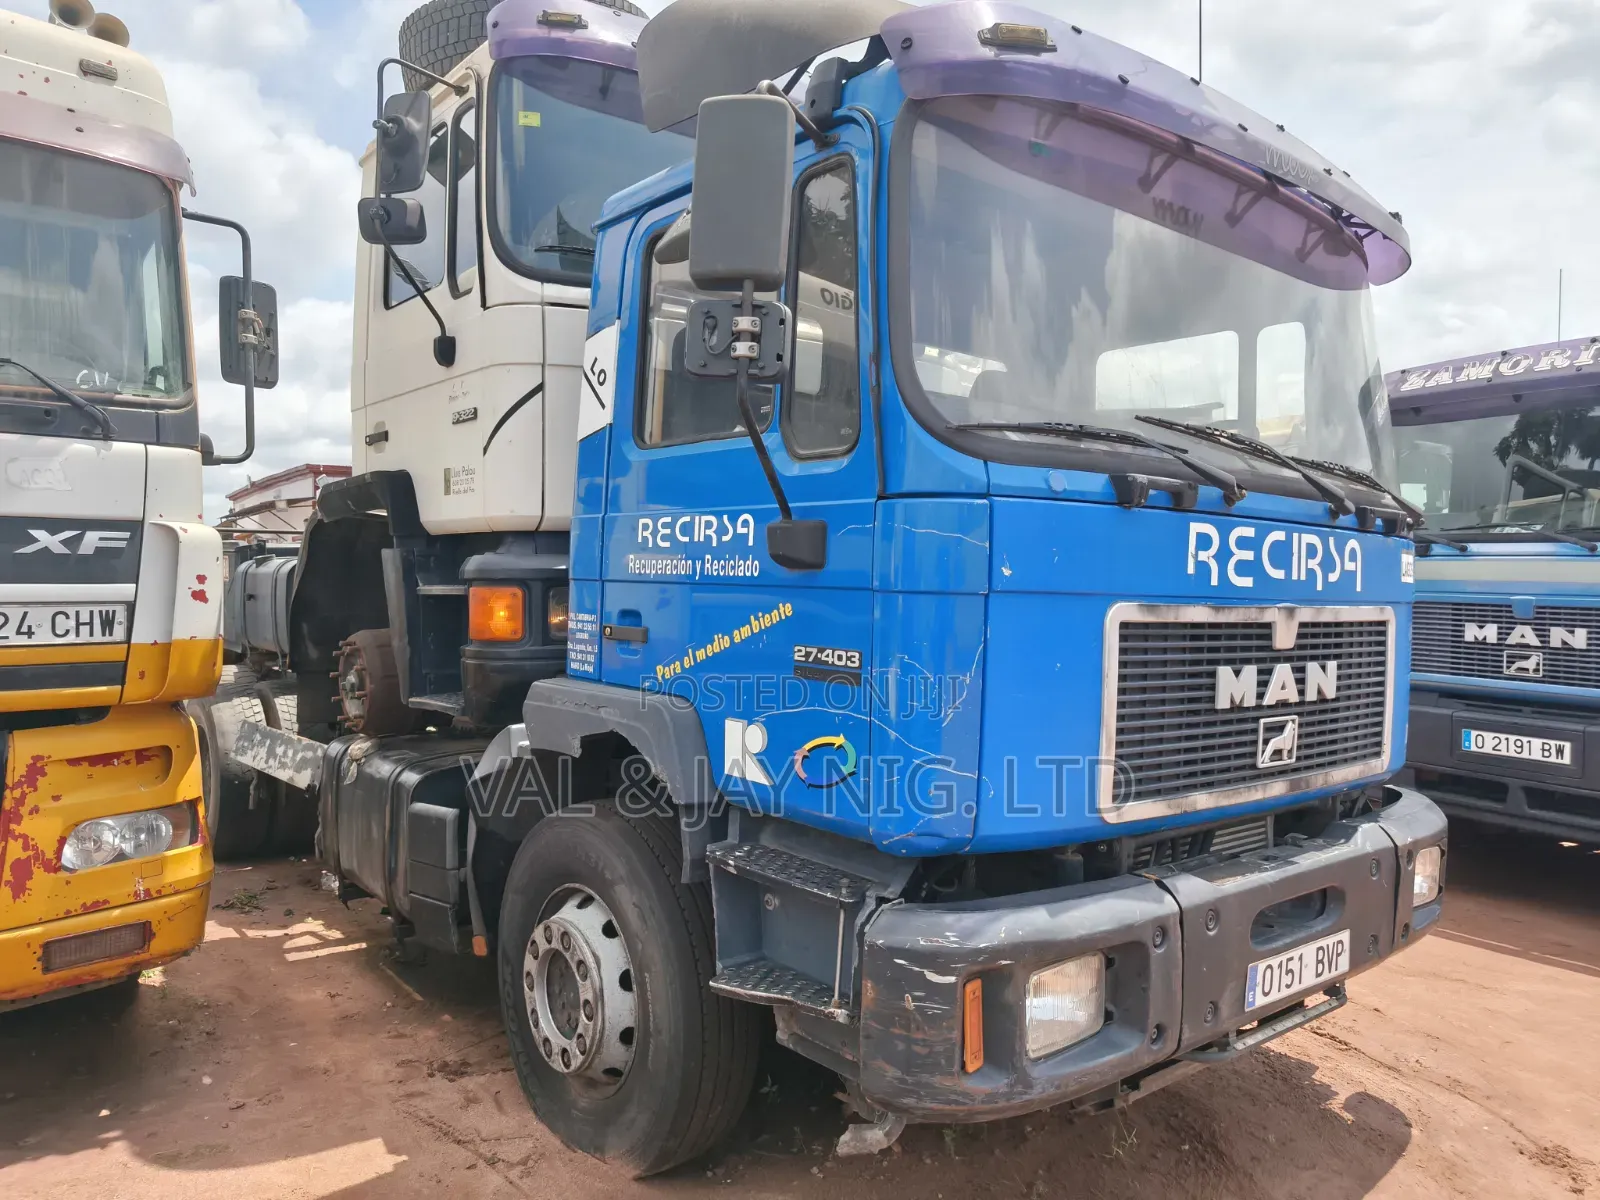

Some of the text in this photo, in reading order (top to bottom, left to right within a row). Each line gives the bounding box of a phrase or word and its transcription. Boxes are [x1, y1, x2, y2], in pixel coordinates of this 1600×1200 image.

[1401, 343, 1600, 391] ZAMORI
[13, 529, 131, 555] XF
[638, 513, 754, 547] RECIRSA
[629, 554, 759, 580] Recuperación y Reciclado
[1187, 522, 1361, 592] RECIRSA
[50, 609, 116, 638] CHW
[1464, 622, 1588, 650] MAN
[656, 602, 793, 682] Para el medio ambiente
[1215, 661, 1337, 710] MAN
[1491, 736, 1532, 756] 2191
[1541, 741, 1566, 761] BW
[1262, 939, 1345, 997] 0151 BVP
